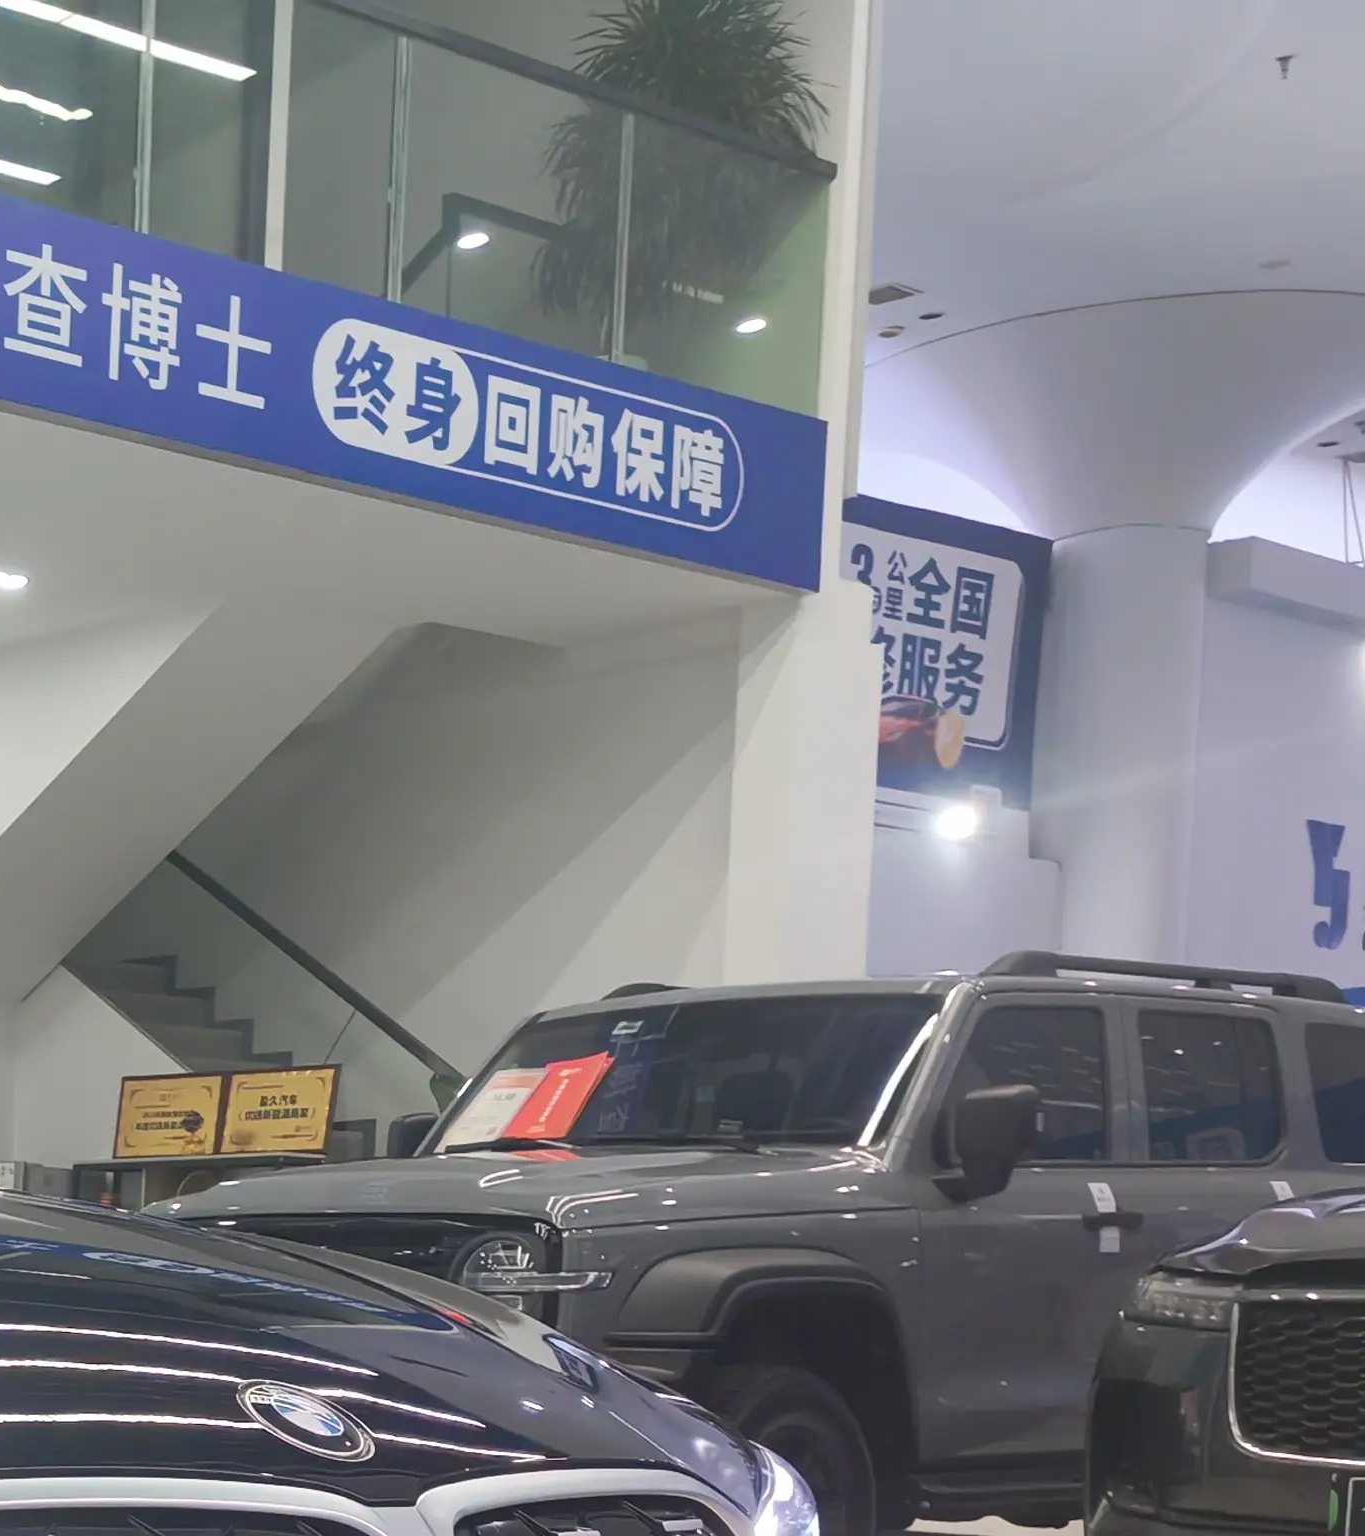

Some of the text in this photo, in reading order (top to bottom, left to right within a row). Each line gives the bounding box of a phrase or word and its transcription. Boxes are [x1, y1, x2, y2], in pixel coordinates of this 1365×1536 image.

[331, 335, 466, 453] 终身
[482, 375, 726, 519] 回购保障
